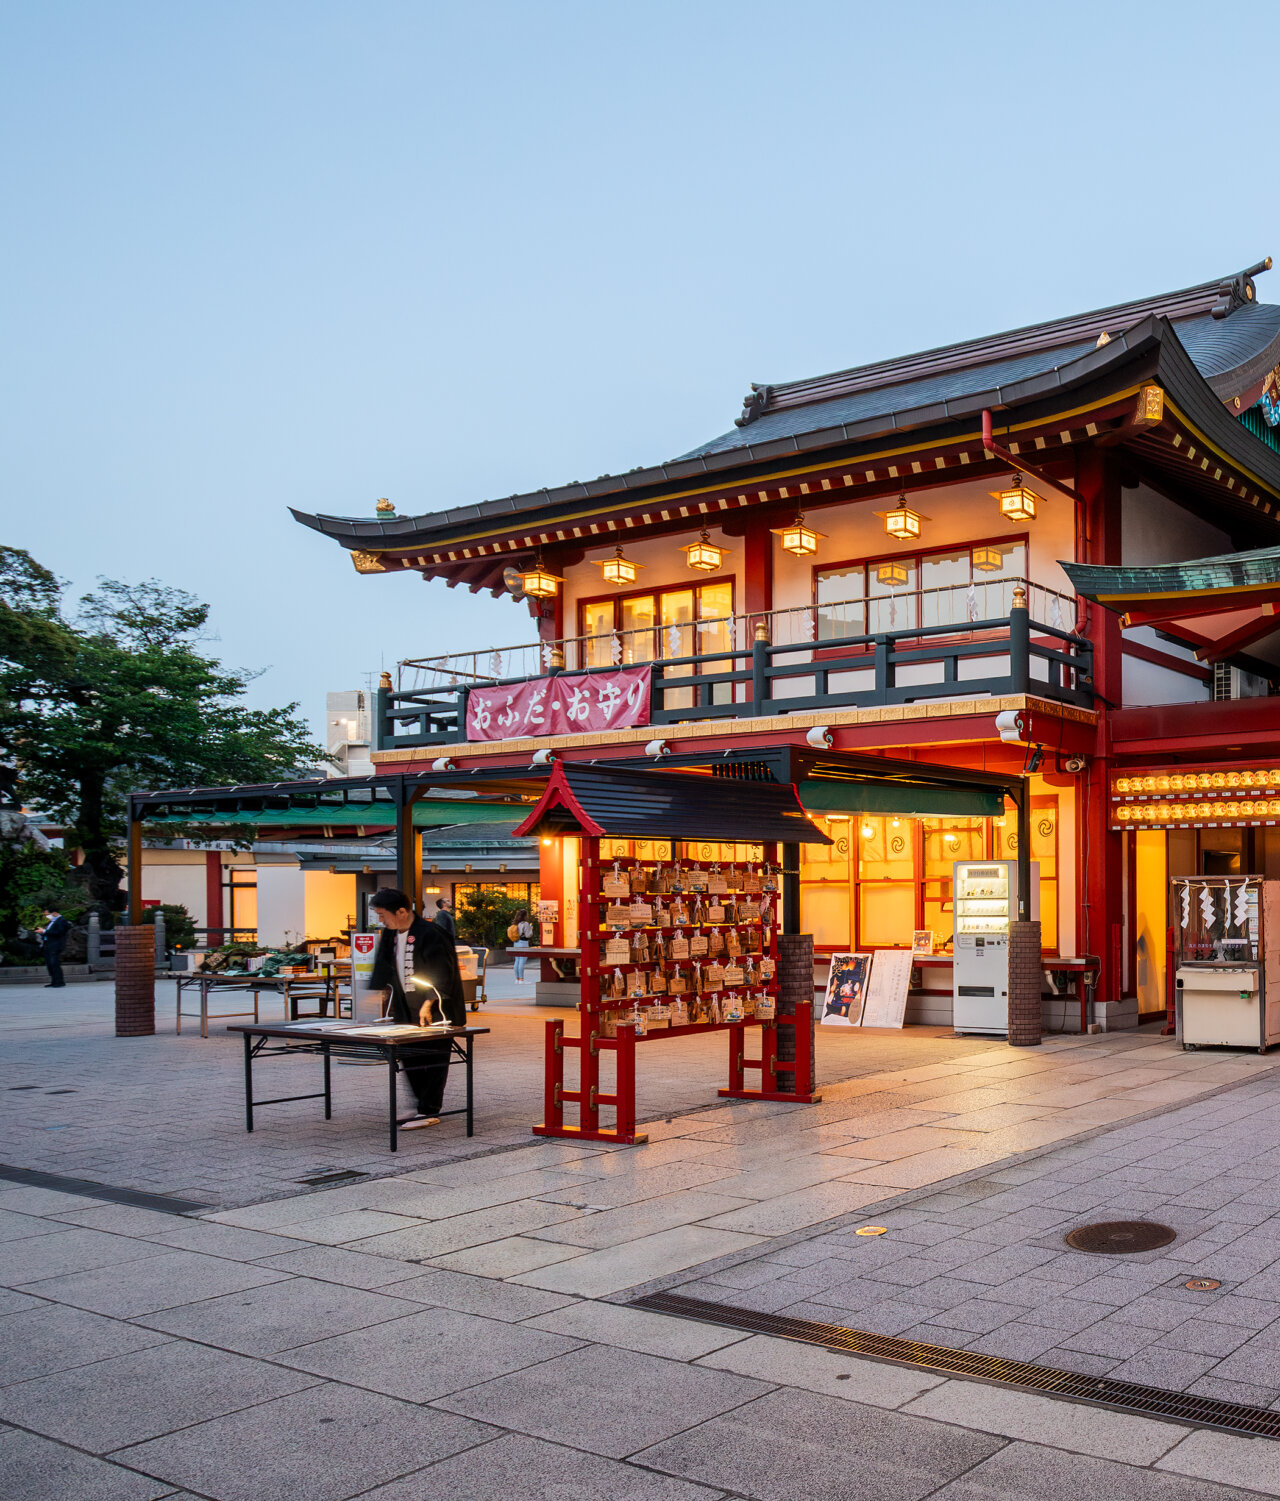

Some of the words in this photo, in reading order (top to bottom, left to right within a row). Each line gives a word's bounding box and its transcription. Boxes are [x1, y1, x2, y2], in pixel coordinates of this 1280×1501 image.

[472, 679, 645, 731] おふだ・お守り
